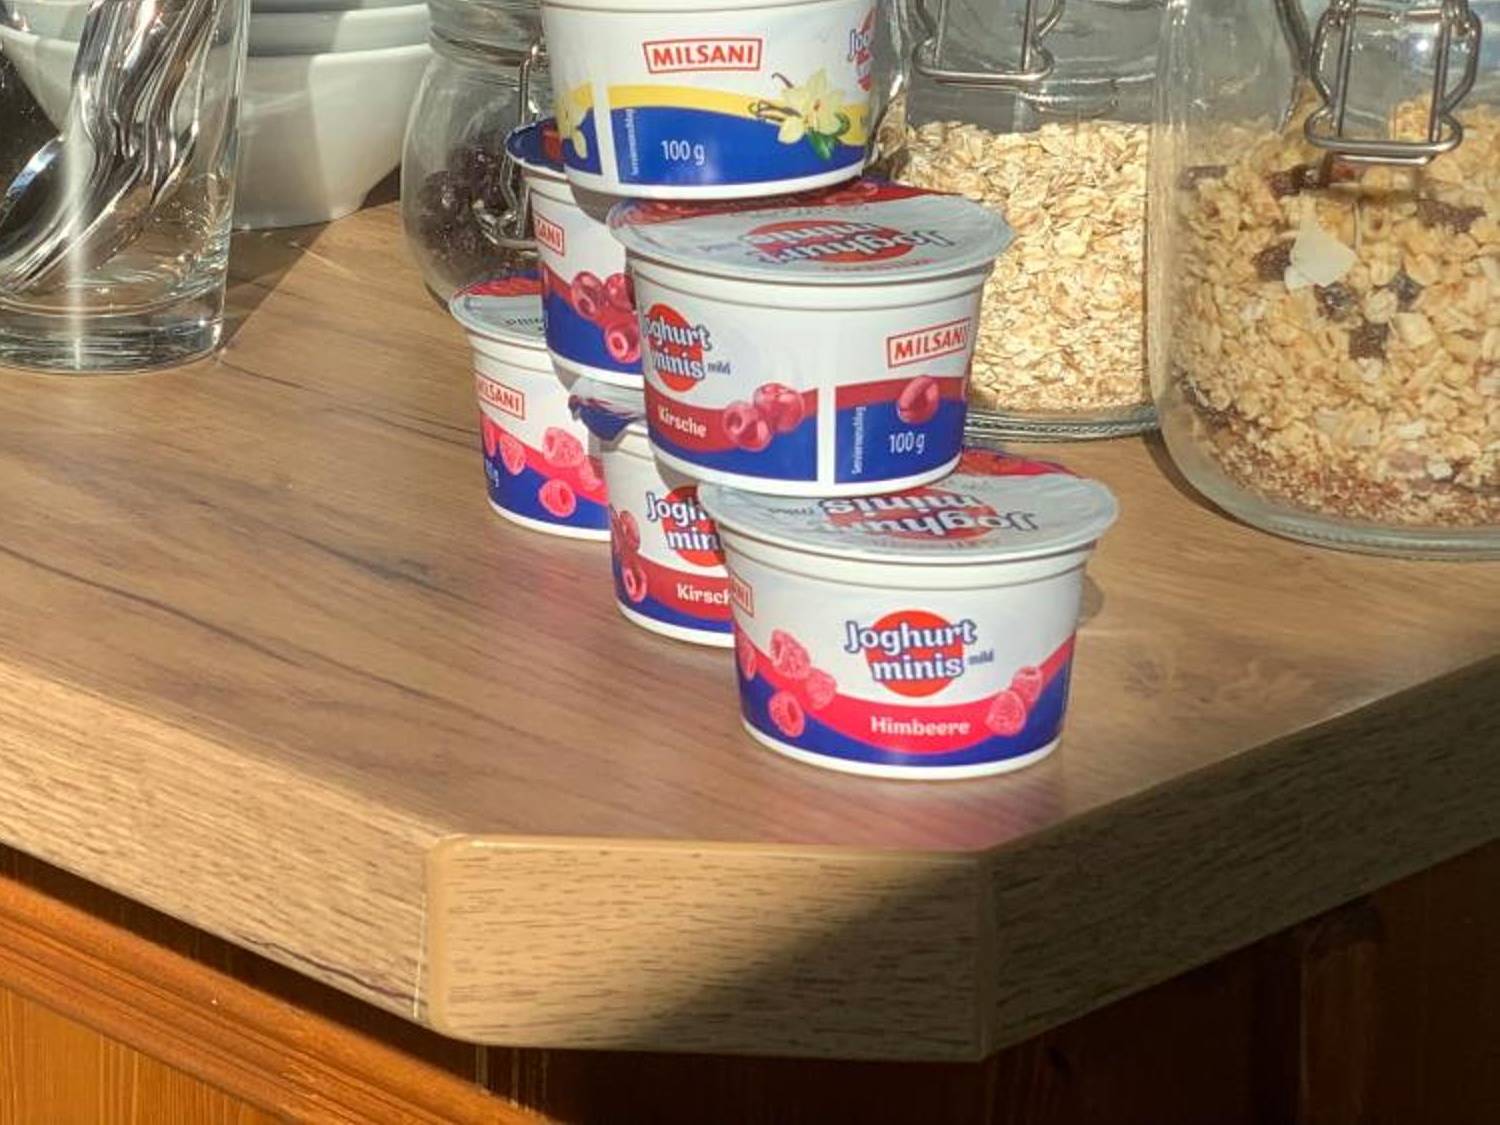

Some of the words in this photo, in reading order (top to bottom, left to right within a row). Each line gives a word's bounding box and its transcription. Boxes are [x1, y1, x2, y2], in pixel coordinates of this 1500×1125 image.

[652, 44, 754, 67] MILSANI
[657, 404, 708, 438] Kirsche
[844, 619, 978, 656] Joghurt
[871, 652, 965, 682] minis
[870, 714, 972, 736] Himbeere
